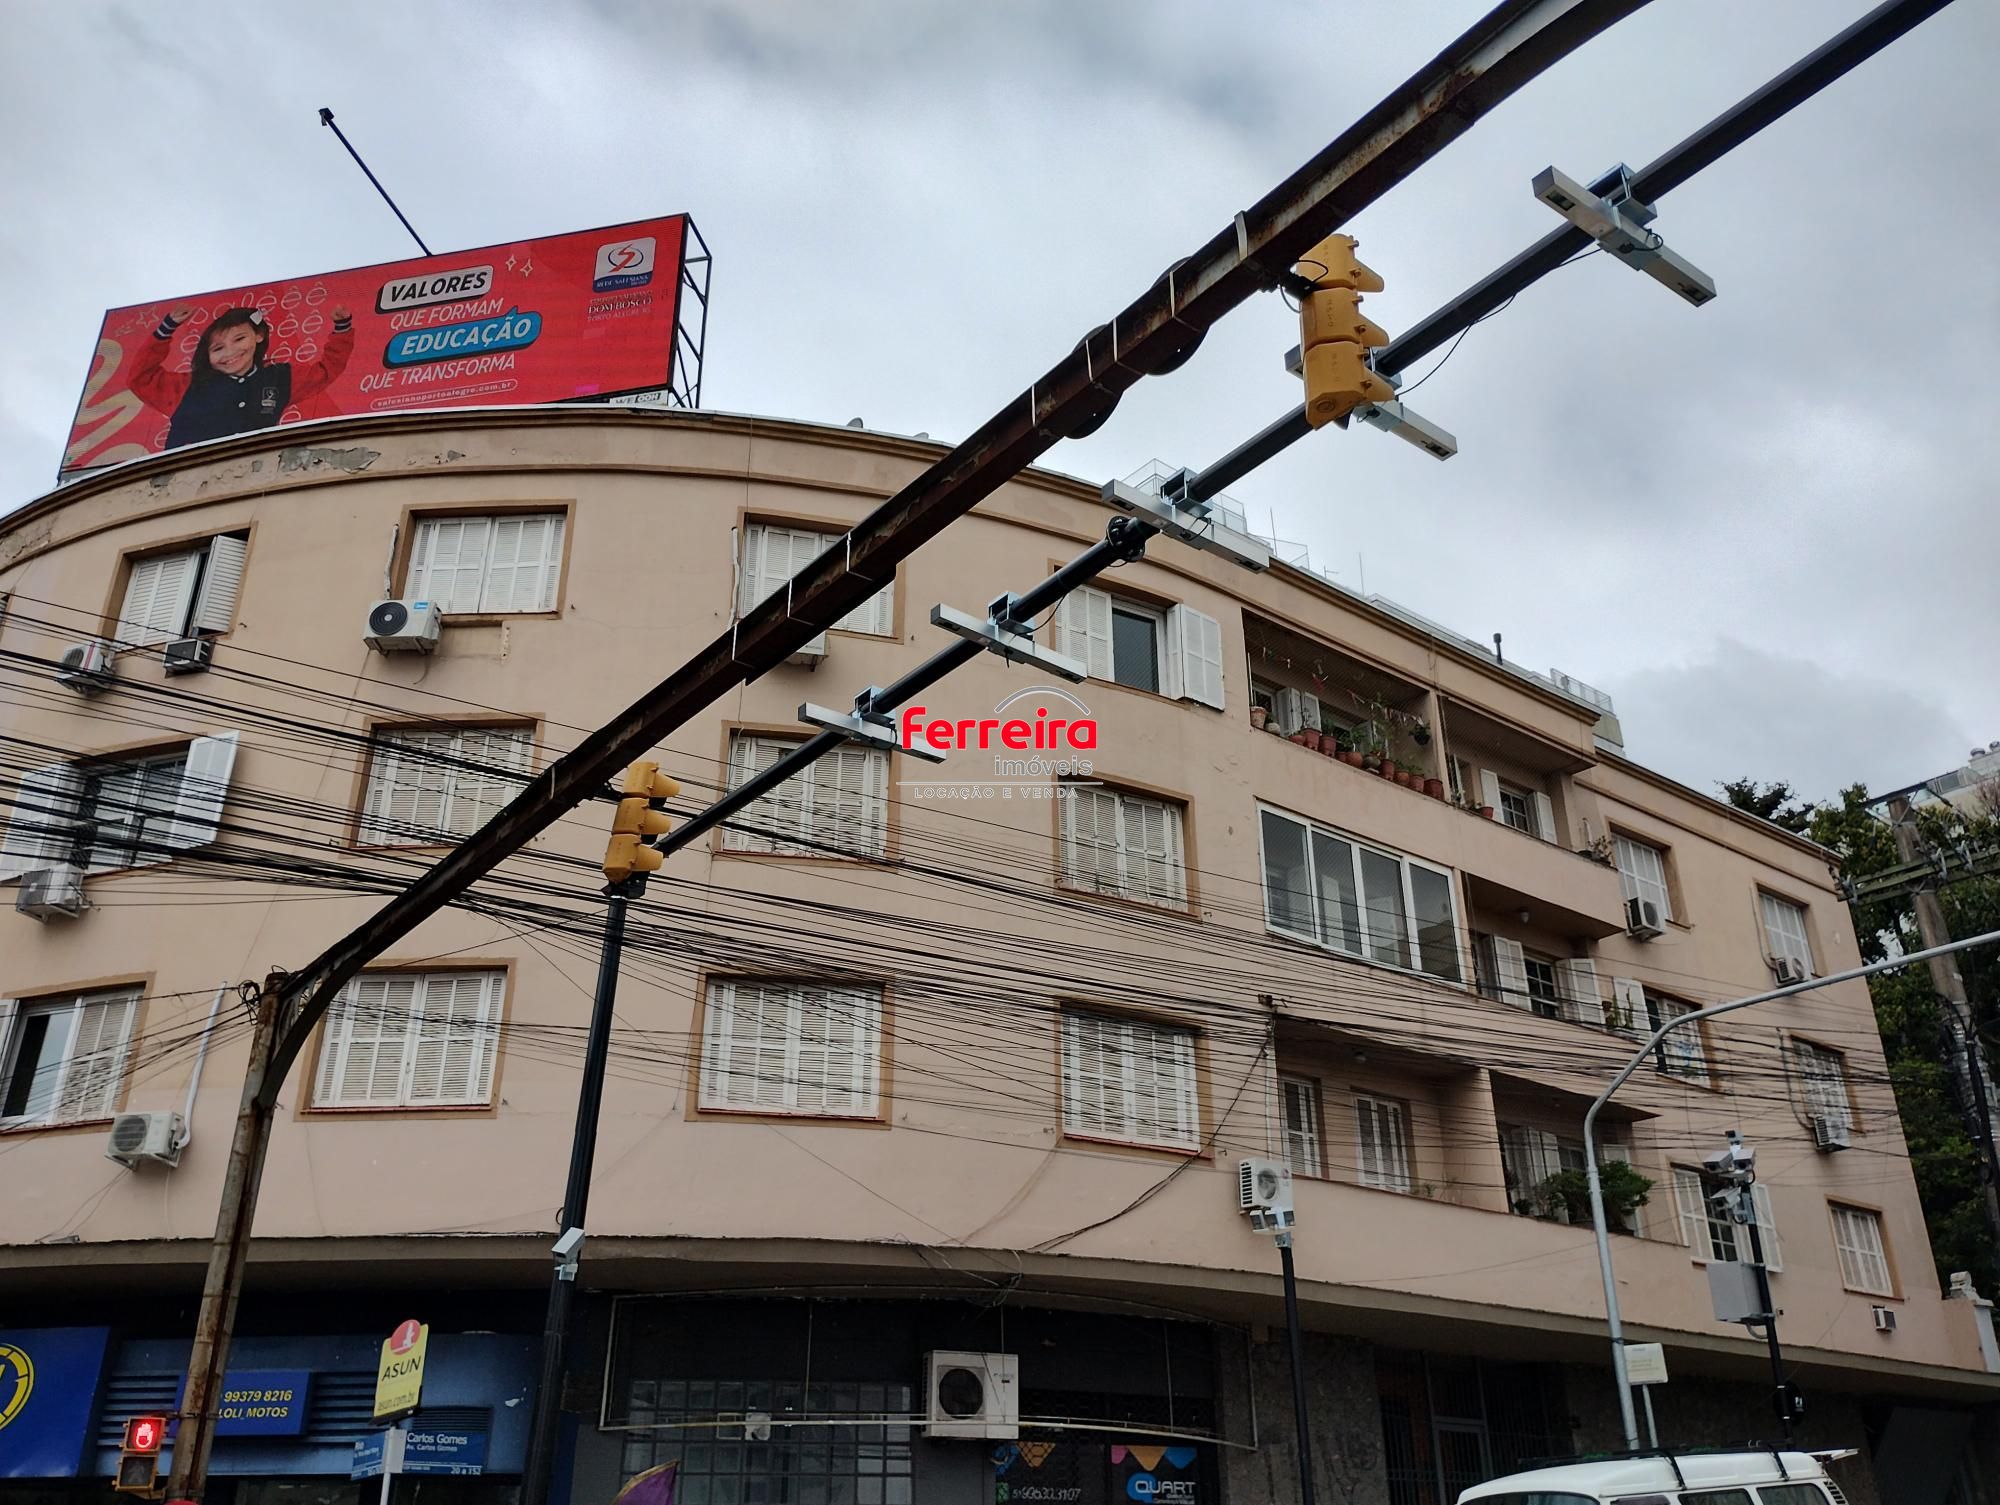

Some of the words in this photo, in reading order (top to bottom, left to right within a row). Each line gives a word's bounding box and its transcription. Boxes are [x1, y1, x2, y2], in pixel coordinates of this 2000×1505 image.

[391, 272, 488, 302] VALORES
[390, 309, 427, 330] QUE
[428, 297, 504, 324] FORMAM
[401, 316, 532, 355] EDUCAÇÃO
[359, 371, 397, 393] QUE
[401, 352, 516, 386] TRANSFORMA
[381, 1356, 421, 1382] ASUN
[223, 1390, 262, 1403] 99379
[263, 1389, 293, 1402] 8216
[407, 1432, 435, 1443] Carlos
[436, 1433, 468, 1445] Gomes
[1135, 1480, 1197, 1494] QUART
